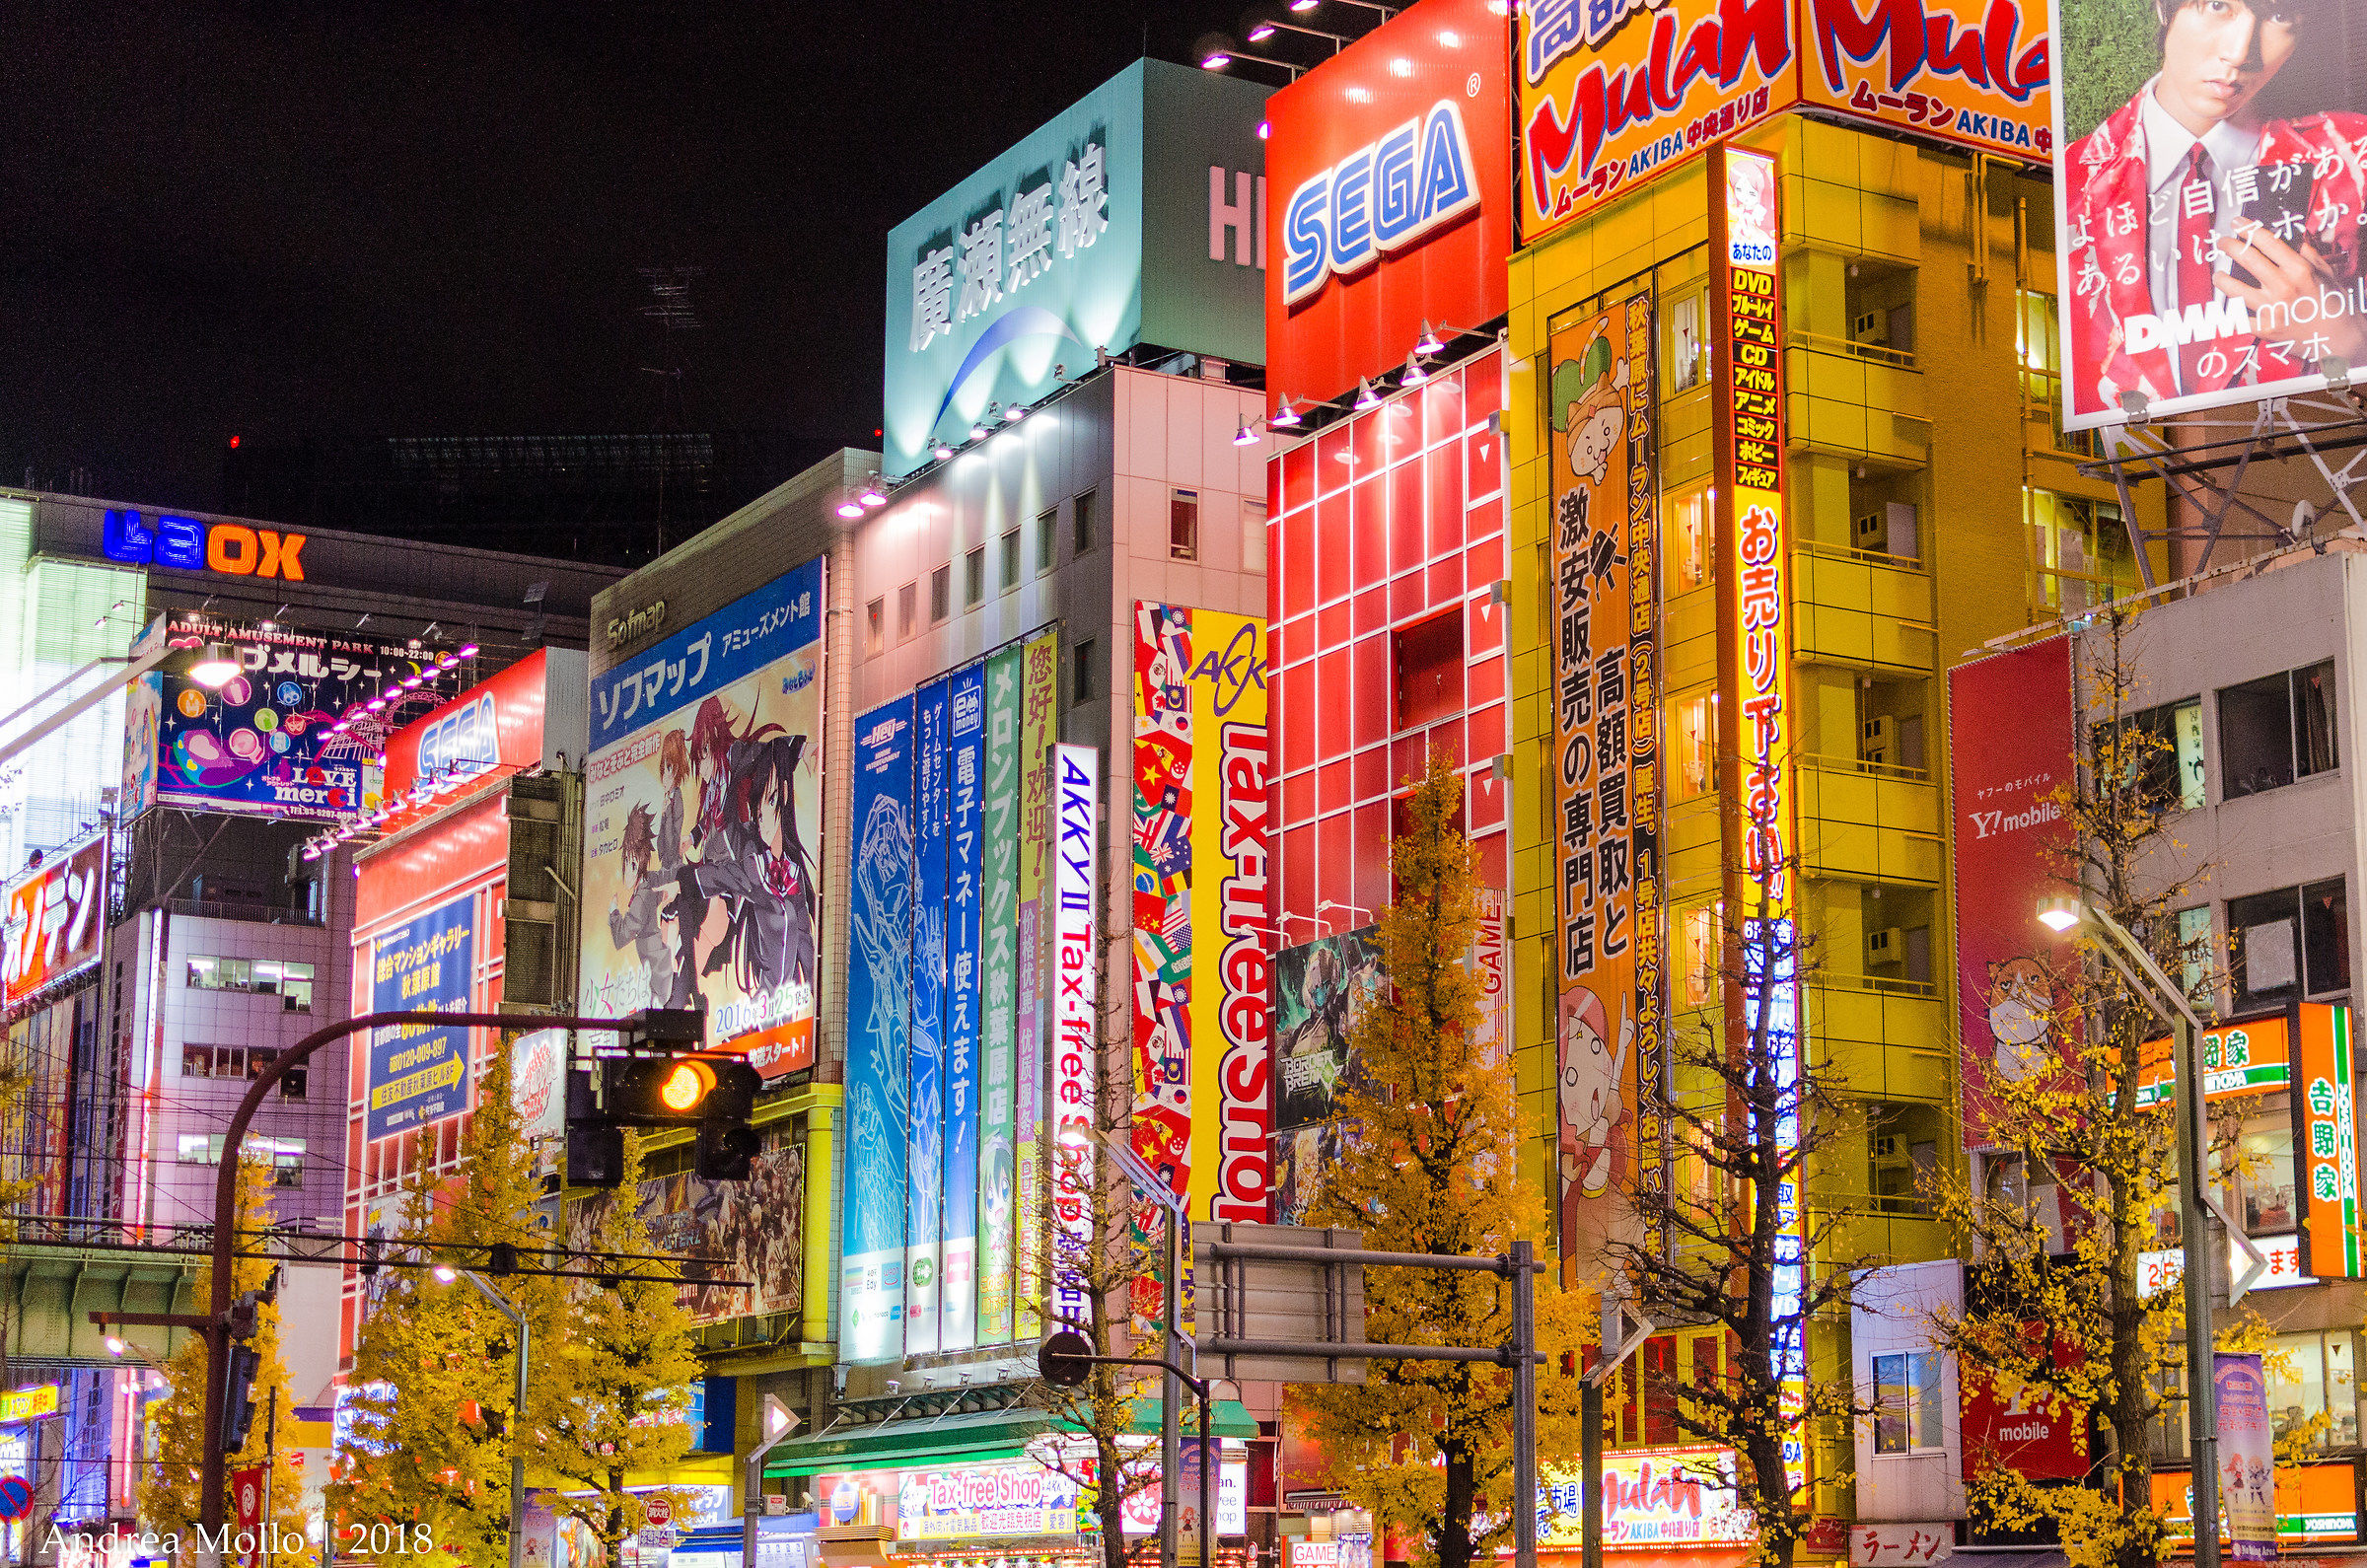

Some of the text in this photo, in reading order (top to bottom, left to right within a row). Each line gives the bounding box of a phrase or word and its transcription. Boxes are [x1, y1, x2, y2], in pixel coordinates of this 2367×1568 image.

[1850, 80, 1956, 128] ムーラン
[1957, 112, 2031, 148] AKIBA
[1554, 86, 1769, 222] ムーラン AKIBA 中央通り店
[1283, 98, 1481, 306] SEGA
[1732, 241, 1772, 263] あなたの
[1733, 268, 1772, 295] DVD
[1732, 294, 1775, 321] ブルーレイ
[1733, 320, 1775, 346] ゲーム
[2124, 296, 2253, 355] DMM
[1740, 343, 1768, 366] CD
[2196, 331, 2332, 380] のスマホ
[1734, 366, 1776, 392] アイドル
[1734, 390, 1776, 418] アニメ
[1736, 414, 1776, 442] コミック
[1738, 440, 1775, 464] ホビー
[1737, 464, 1776, 490] フィギュア
[169, 618, 223, 637] ADULT
[226, 627, 328, 651] AMUSEMENT
[331, 639, 375, 656] PARK
[607, 600, 666, 651] Sofmap
[722, 591, 812, 658] アミューズメント館
[210, 641, 383, 680] ブメルシー
[599, 631, 712, 732] ソフマップ
[416, 690, 501, 805] SEGA
[871, 720, 897, 747] Hey
[1559, 482, 1596, 981] 激安販売の専門店
[292, 766, 357, 788] LOVE
[931, 702, 943, 838] ゲームセンターを
[1976, 771, 2051, 802] ヤフーのモバイル
[1594, 644, 1631, 959] 高額買取と
[1061, 751, 1092, 889] AKKY
[987, 663, 1013, 1124] メロンブックス秋葉原店
[951, 745, 976, 1154] 電子マネー使えます!
[1476, 898, 1503, 995] GAME
[1060, 923, 1092, 1105] Tax-free
[1277, 1049, 1333, 1075] BORDER
[2336, 1082, 2354, 1200] YOSHINOYA
[1999, 1421, 2049, 1444] mobile
[1000, 1472, 1041, 1505] Shop
[648, 1507, 670, 1519] 消火栓
[2304, 1517, 2355, 1531] YOSHINOYA
[1630, 1522, 1659, 1539] AKIBA
[1862, 1529, 1941, 1562] ラーメン
[1294, 1544, 1336, 1561] GAME
